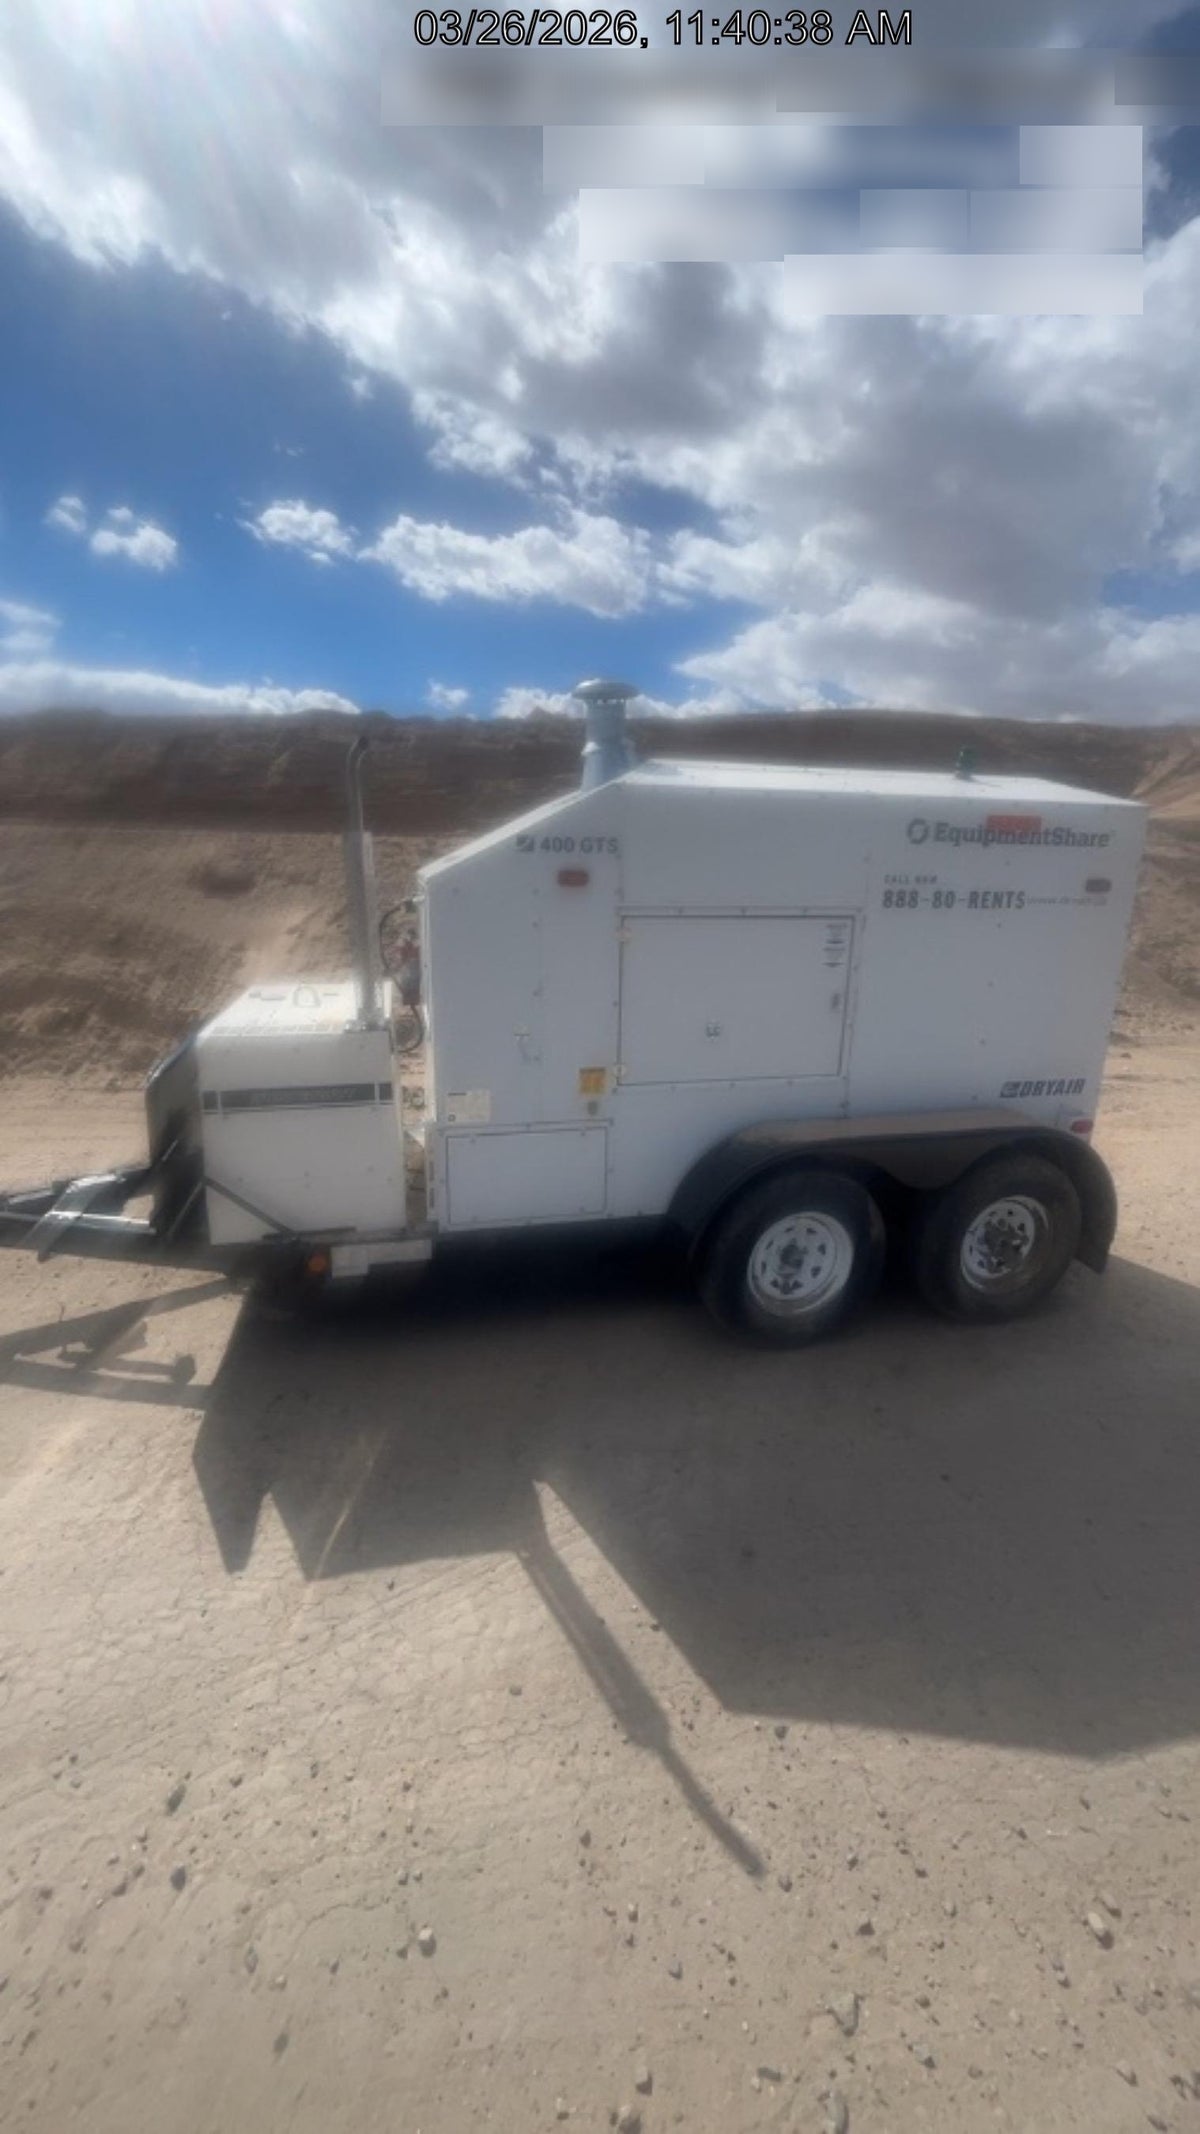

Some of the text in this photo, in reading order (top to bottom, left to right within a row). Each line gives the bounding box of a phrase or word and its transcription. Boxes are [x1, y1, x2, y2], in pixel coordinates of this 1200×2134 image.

[934, 821, 1111, 848] EquipmentShare
[539, 836, 619, 854] 400 GTS
[882, 889, 1026, 909] 888-80-RENTS
[1019, 1078, 1087, 1098] DRYAIR
